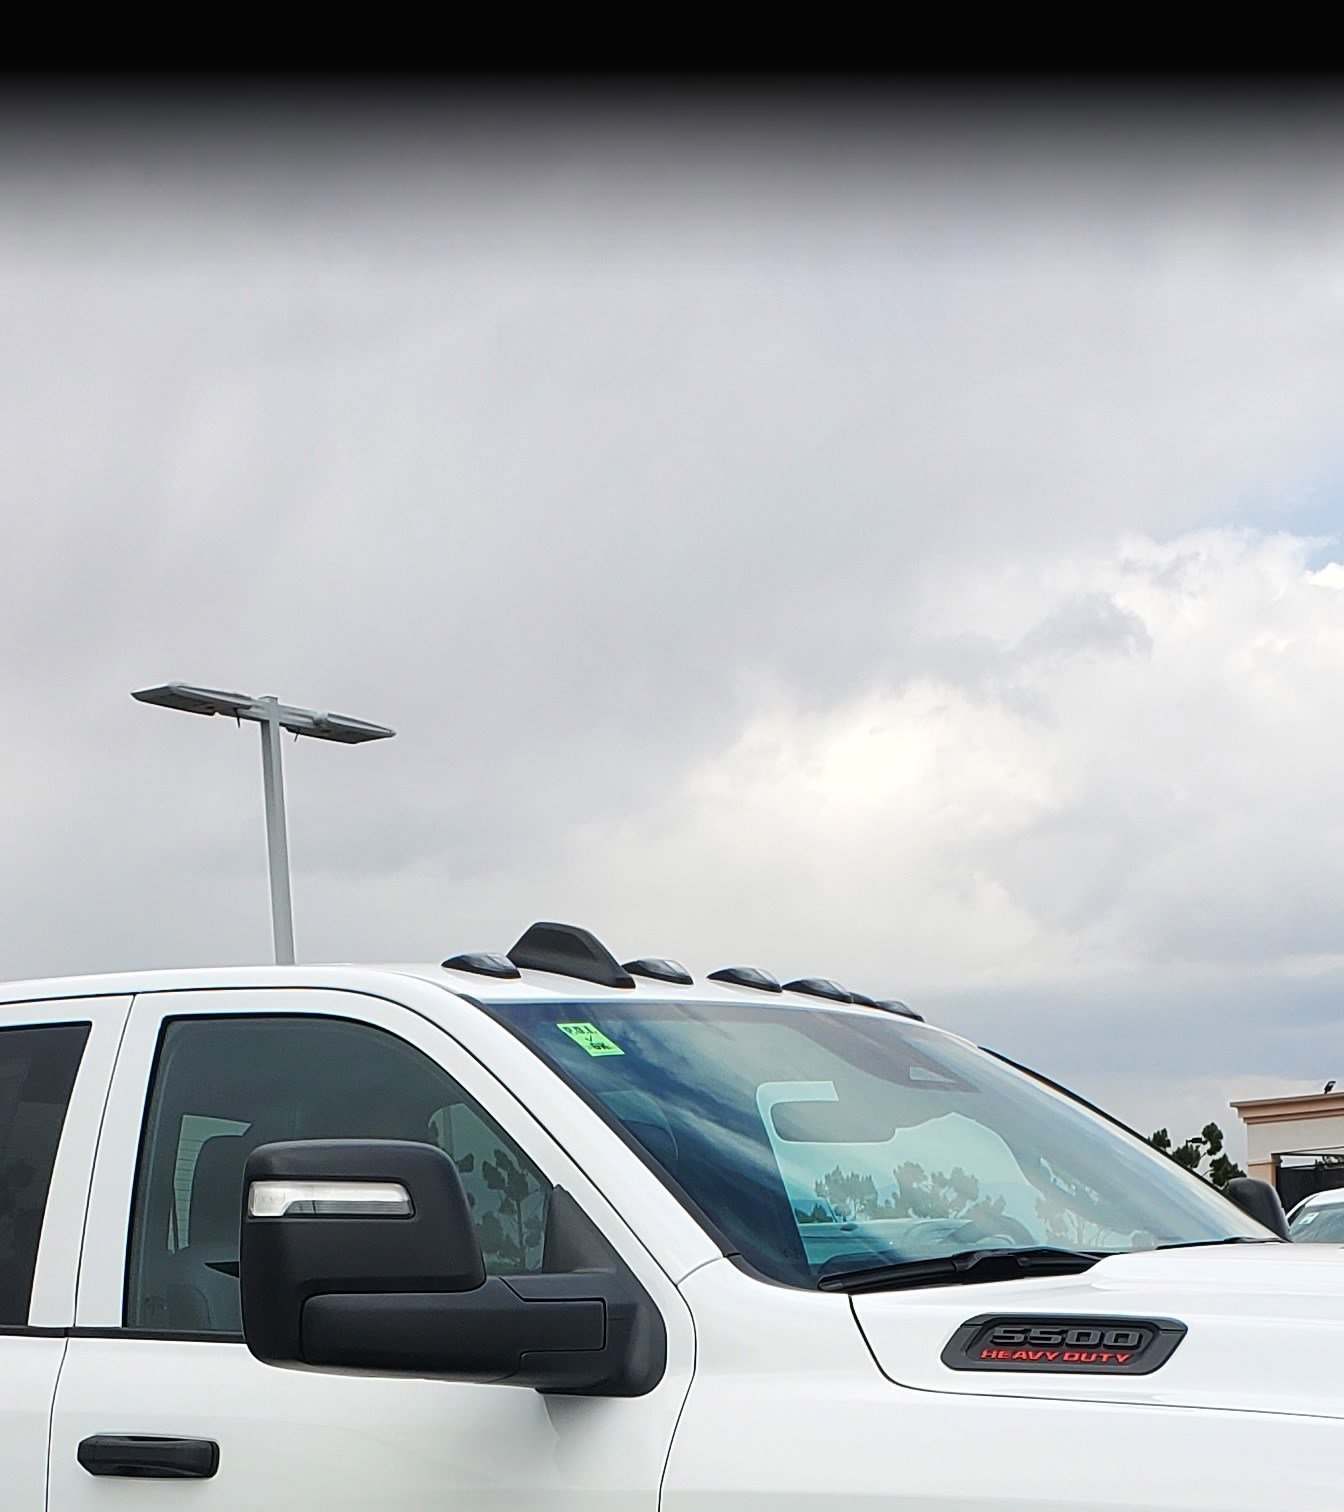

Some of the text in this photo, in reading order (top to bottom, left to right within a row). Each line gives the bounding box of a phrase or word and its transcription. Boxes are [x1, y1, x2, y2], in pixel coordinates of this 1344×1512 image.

[990, 1326, 1144, 1350] 5500
[980, 1349, 1131, 1364] HEAVY DUTY
